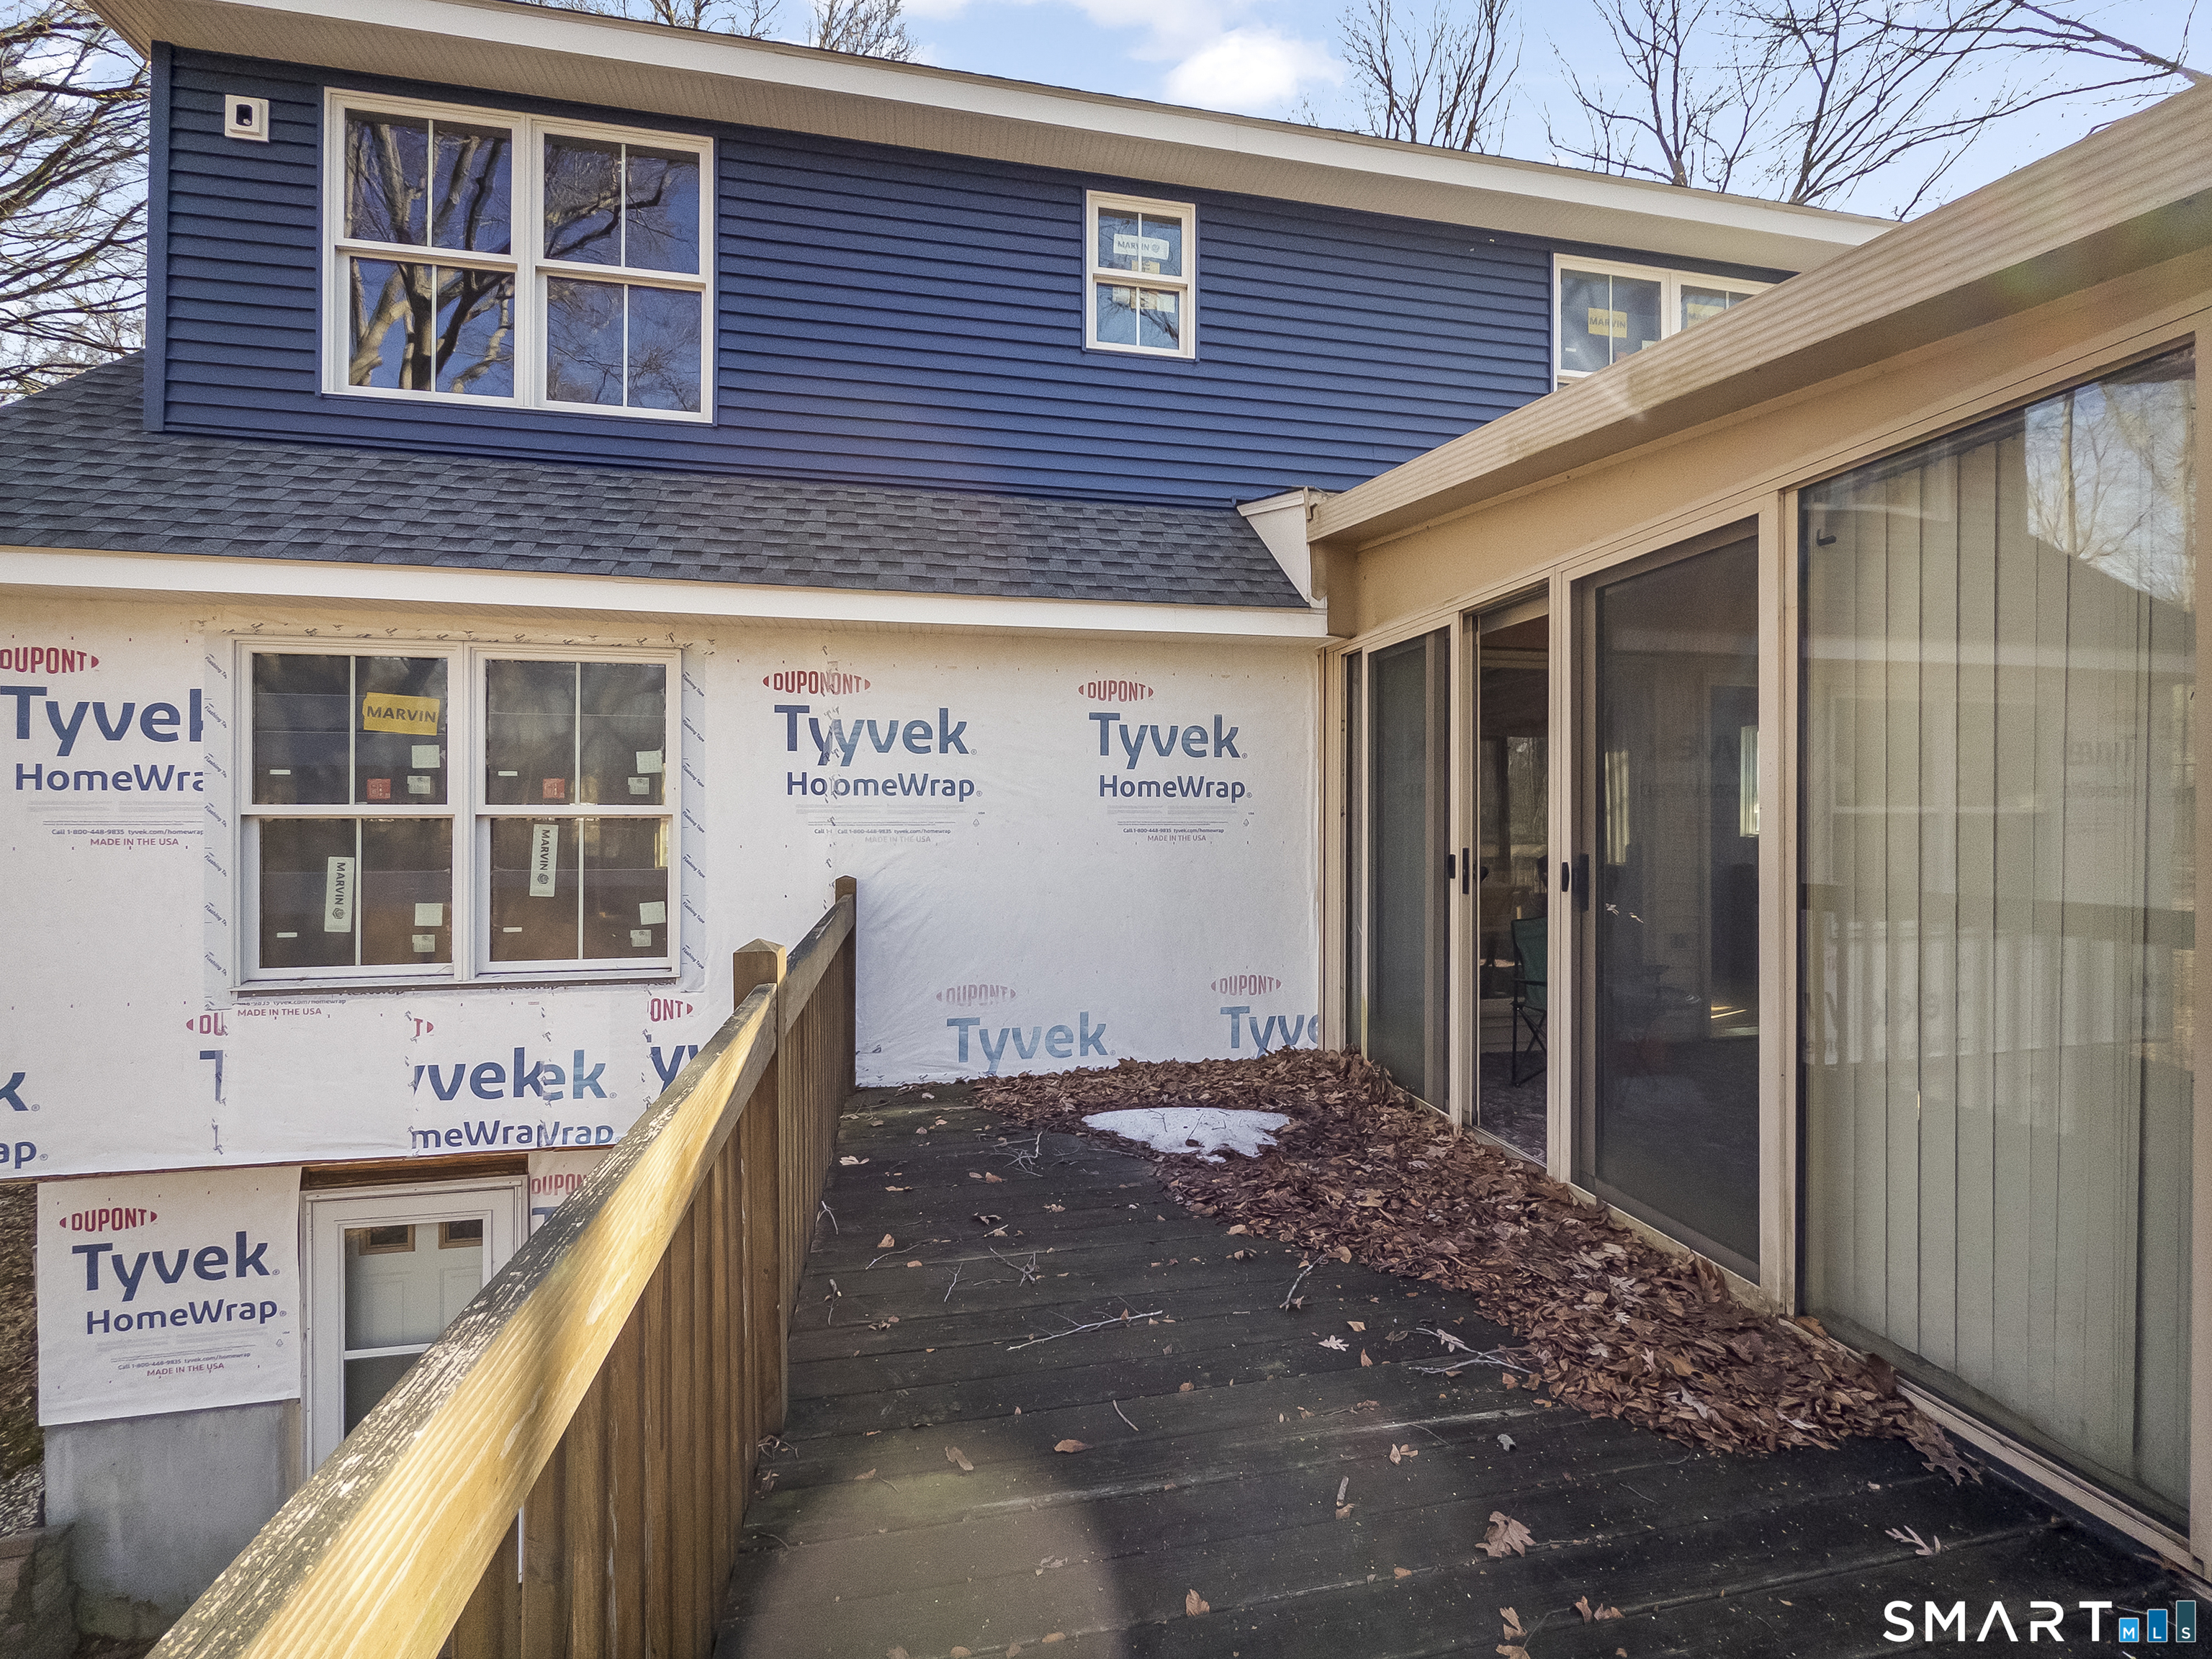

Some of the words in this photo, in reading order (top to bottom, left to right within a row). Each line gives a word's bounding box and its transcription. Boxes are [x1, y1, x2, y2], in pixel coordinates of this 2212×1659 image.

[1117, 240, 1150, 251] MARIN
[0, 647, 87, 674] DUPONT
[1088, 680, 1146, 702] DUPONT
[367, 706, 436, 722] MARVIN
[1089, 712, 1241, 770] Tyvek
[1100, 775, 1246, 803] HomeWrap
[539, 830, 550, 871] MARVIN
[336, 862, 346, 905] MARVIN
[946, 984, 1007, 1006] DUPONT
[1220, 975, 1274, 996] DUPONT
[947, 1011, 1108, 1076] Tyvek
[71, 1208, 147, 1232] DUPONT
[72, 1231, 270, 1302] Tyvek
[87, 1299, 277, 1334] HomeWrap
